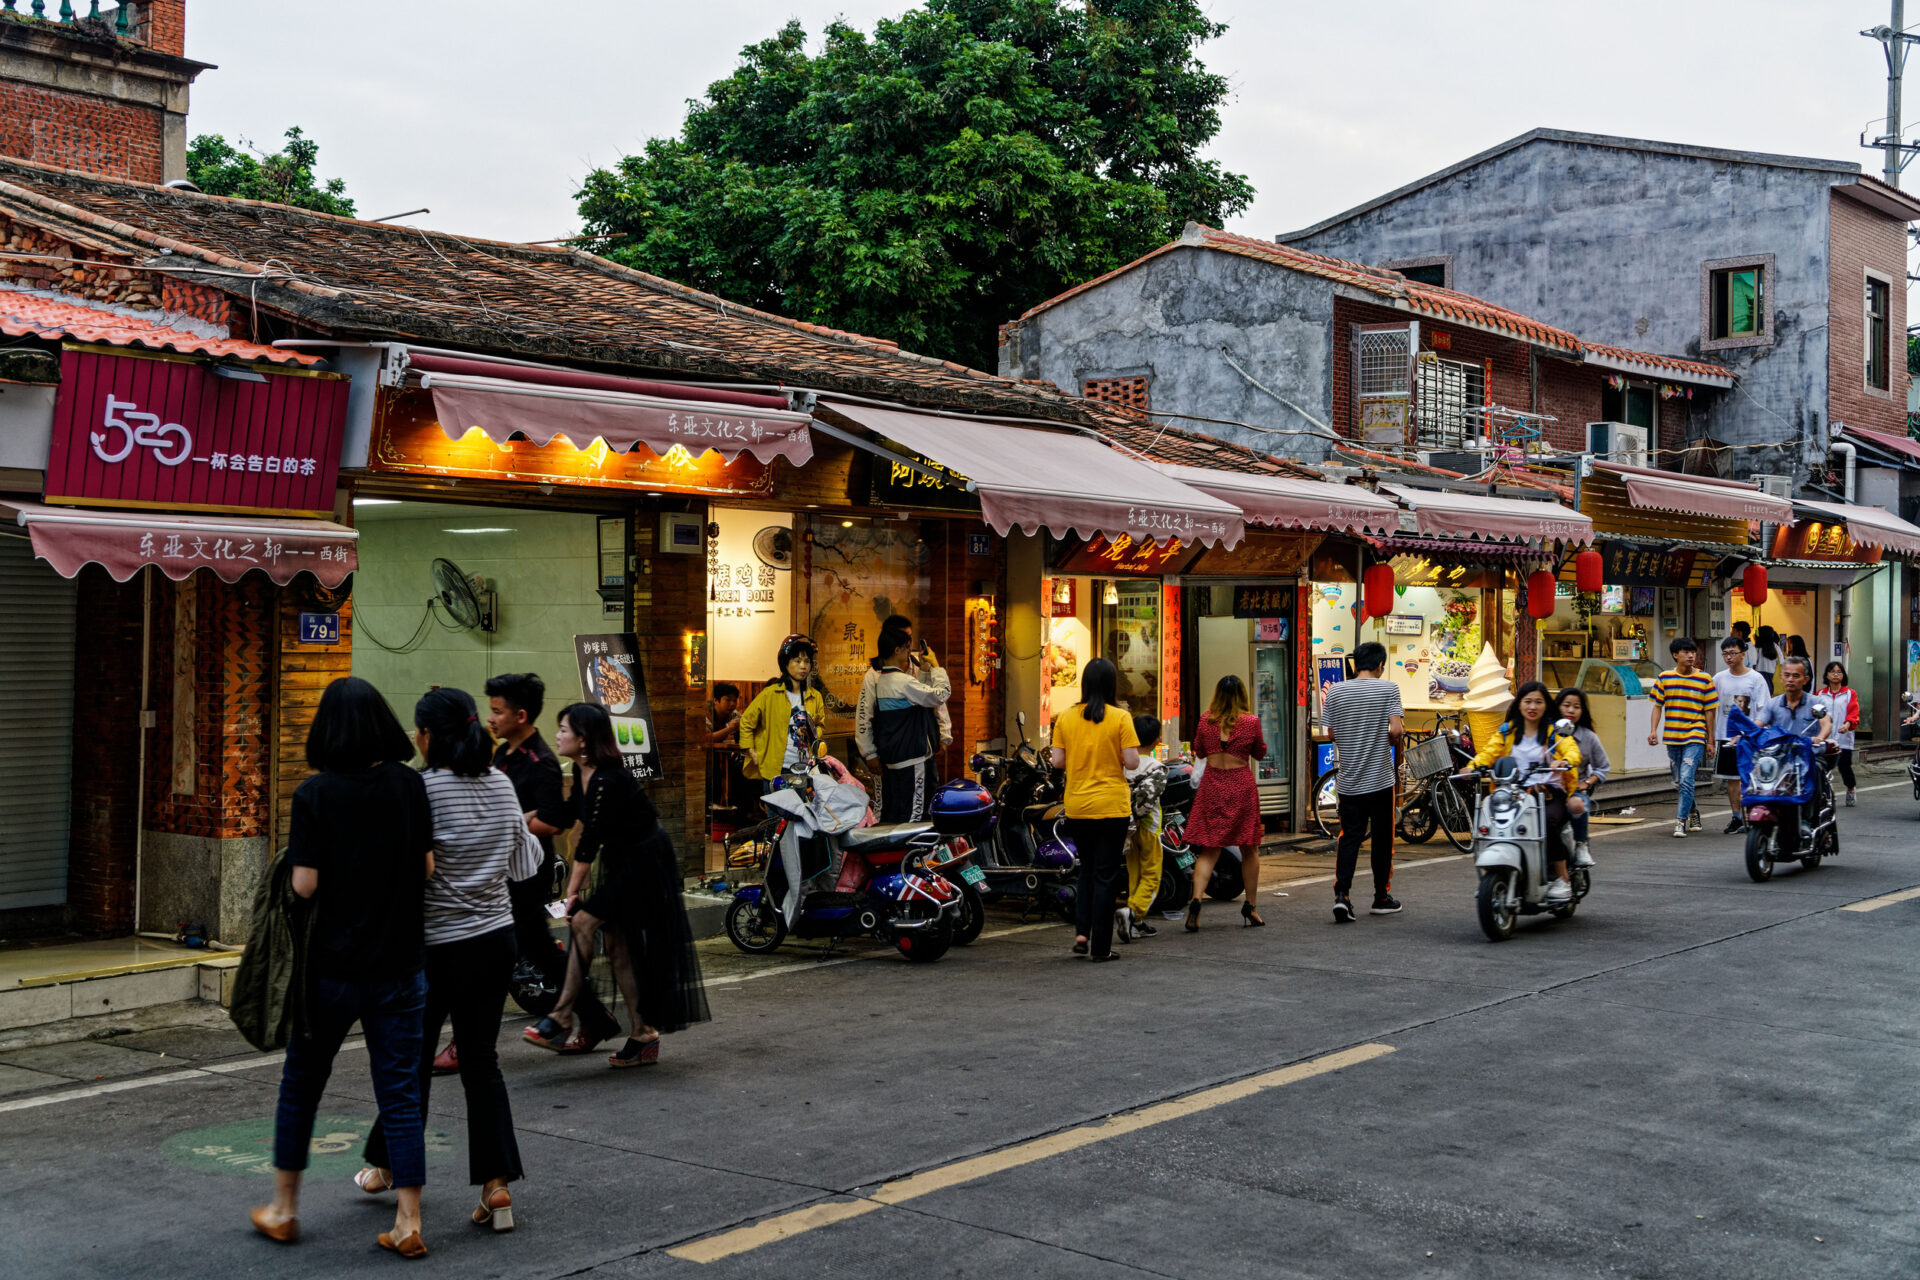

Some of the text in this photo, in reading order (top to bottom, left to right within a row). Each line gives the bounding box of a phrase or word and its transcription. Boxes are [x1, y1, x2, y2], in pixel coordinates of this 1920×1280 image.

[90, 394, 192, 466] 520
[193, 451, 317, 476] 一杯会告白的茶
[973, 542, 983, 553] 81
[747, 589, 775, 603] BONE
[309, 624, 328, 639] 79
[612, 654, 636, 665] 买5送1
